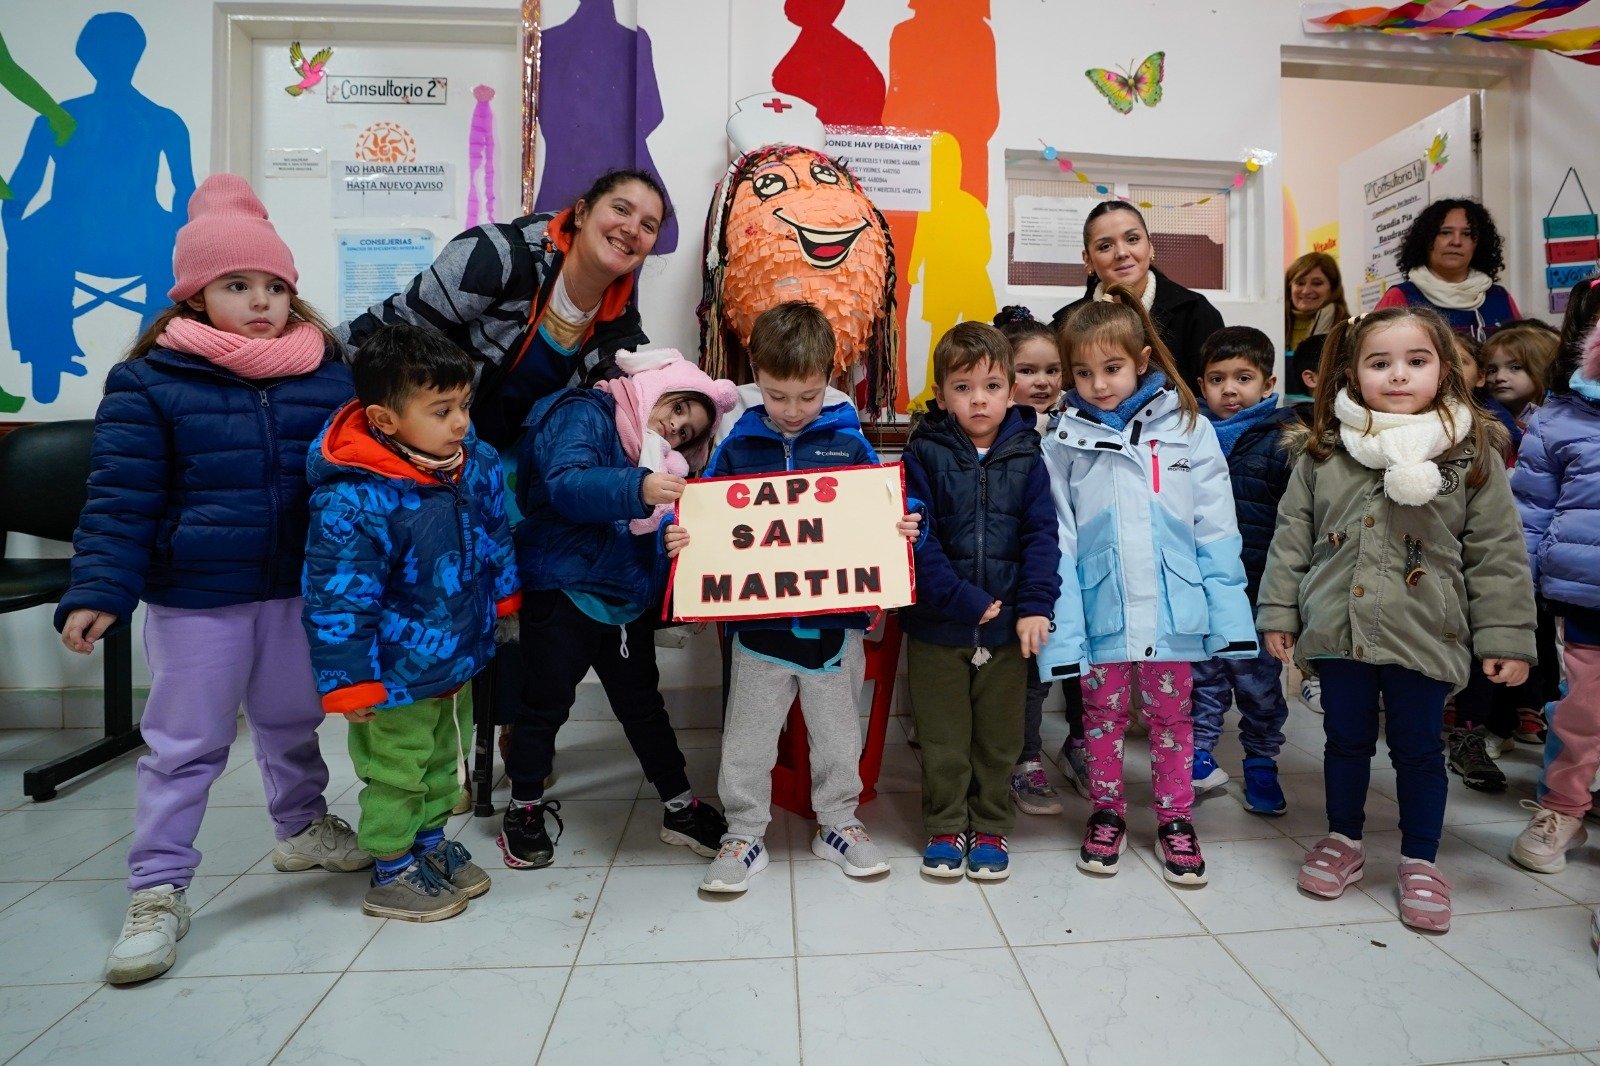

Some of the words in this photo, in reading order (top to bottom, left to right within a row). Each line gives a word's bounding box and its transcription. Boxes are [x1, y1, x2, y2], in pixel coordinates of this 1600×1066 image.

[341, 79, 423, 99] Consultorio
[427, 80, 437, 98] 2
[854, 141, 872, 149] HAY
[874, 142, 922, 151] PEDIATRIA?
[345, 165, 360, 173] NO
[362, 165, 394, 173] HABRA
[397, 165, 445, 173] PEDIATRIA
[347, 181, 377, 190] HASTA
[379, 181, 413, 190] NUEVO
[415, 181, 444, 190] AVISO
[1372, 171, 1413, 199] Consultorio
[1376, 217, 1400, 233] Claudia
[1401, 213, 1413, 223] Pia
[360, 238, 412, 246] CONSEJERIAS
[726, 476, 839, 509] CAPS
[731, 517, 825, 550] SAN
[701, 566, 882, 603] MARTIN
